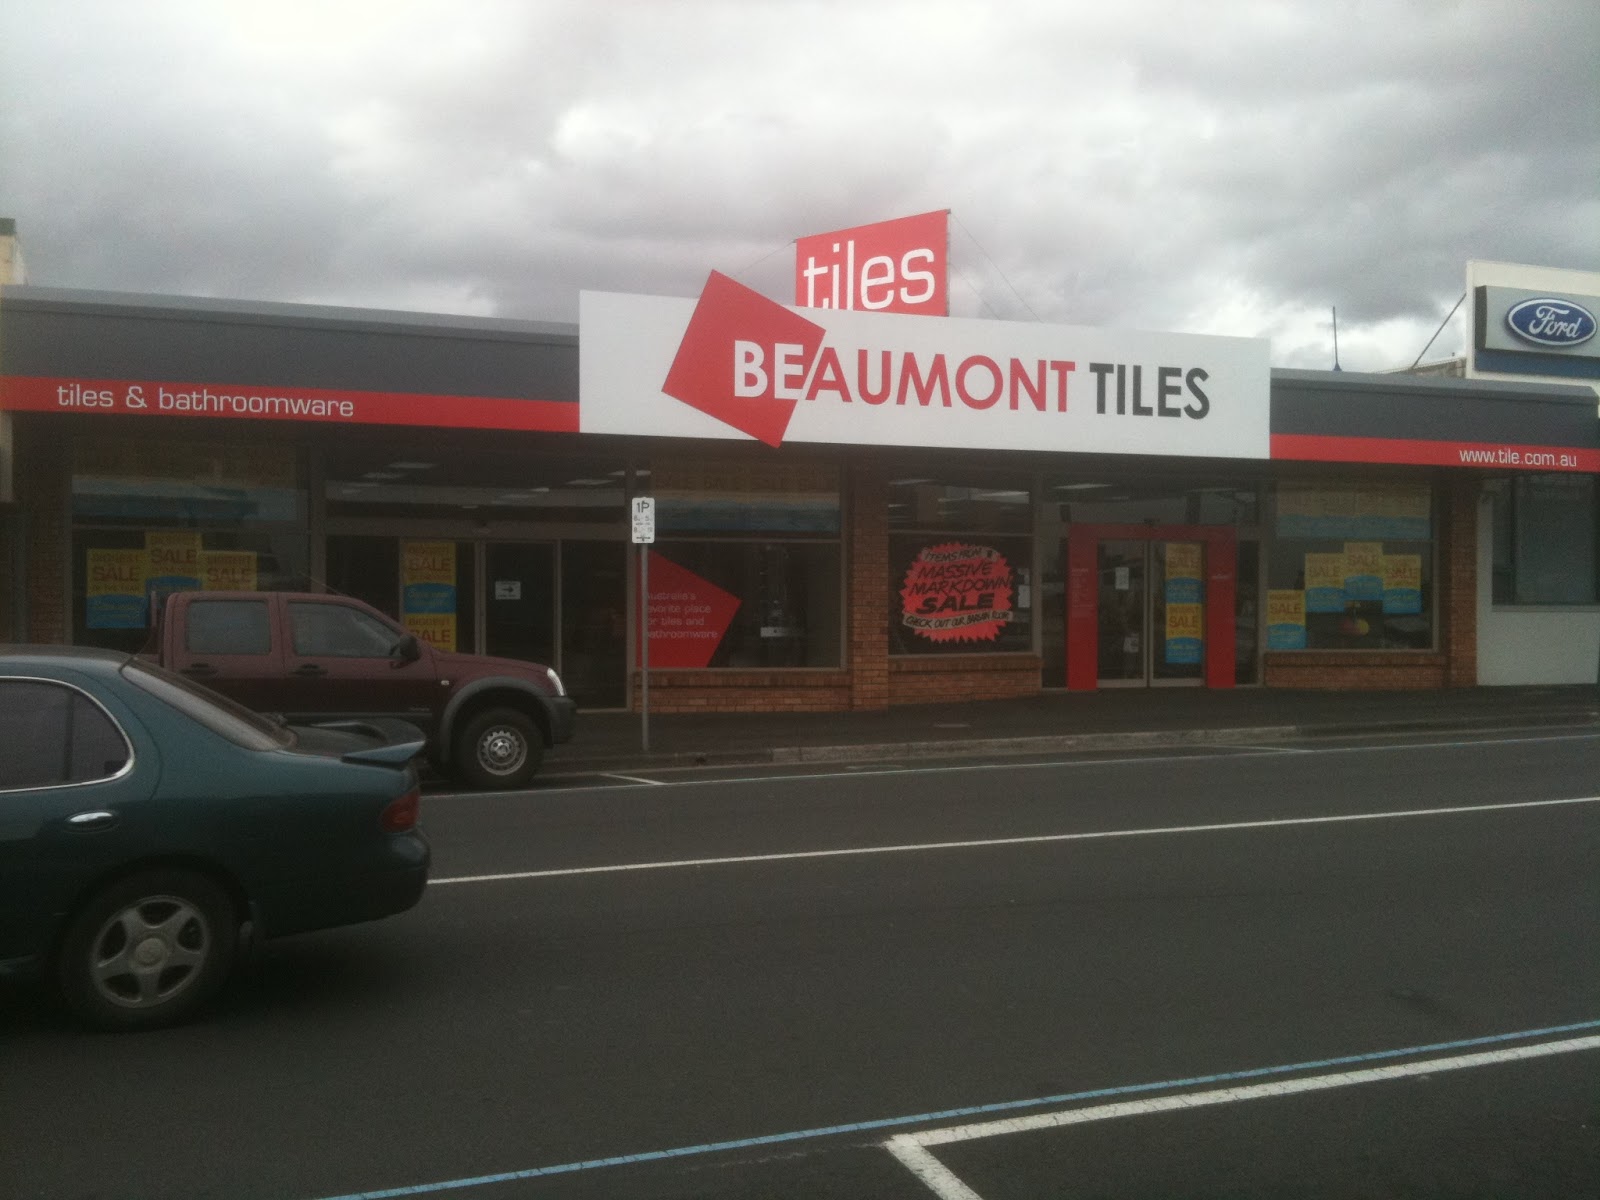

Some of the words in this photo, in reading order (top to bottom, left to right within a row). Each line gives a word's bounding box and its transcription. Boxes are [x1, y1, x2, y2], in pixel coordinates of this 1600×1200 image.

[804, 240, 935, 310] tiles
[1529, 305, 1582, 339] Ford
[733, 339, 1075, 413] BEAUMONT
[1089, 362, 1211, 420] TILES
[57, 384, 114, 406] tiles
[125, 386, 147, 408] &
[159, 387, 354, 417] bathroomware
[1459, 448, 1577, 467] www.tile.com.au
[636, 500, 649, 513] 1P
[151, 549, 196, 564] SALE
[1348, 555, 1376, 566] SALE
[408, 558, 451, 571] SALE
[918, 561, 993, 579] MASSIVE
[1309, 566, 1340, 577] SALE
[93, 566, 140, 581] SALE
[207, 567, 251, 582] SALE
[909, 576, 1010, 596] MARKDOWN
[916, 593, 995, 614] SALE
[1270, 603, 1302, 615] SALE
[686, 617, 704, 626] and
[906, 616, 932, 628] CHECK
[1169, 615, 1199, 628] SALE
